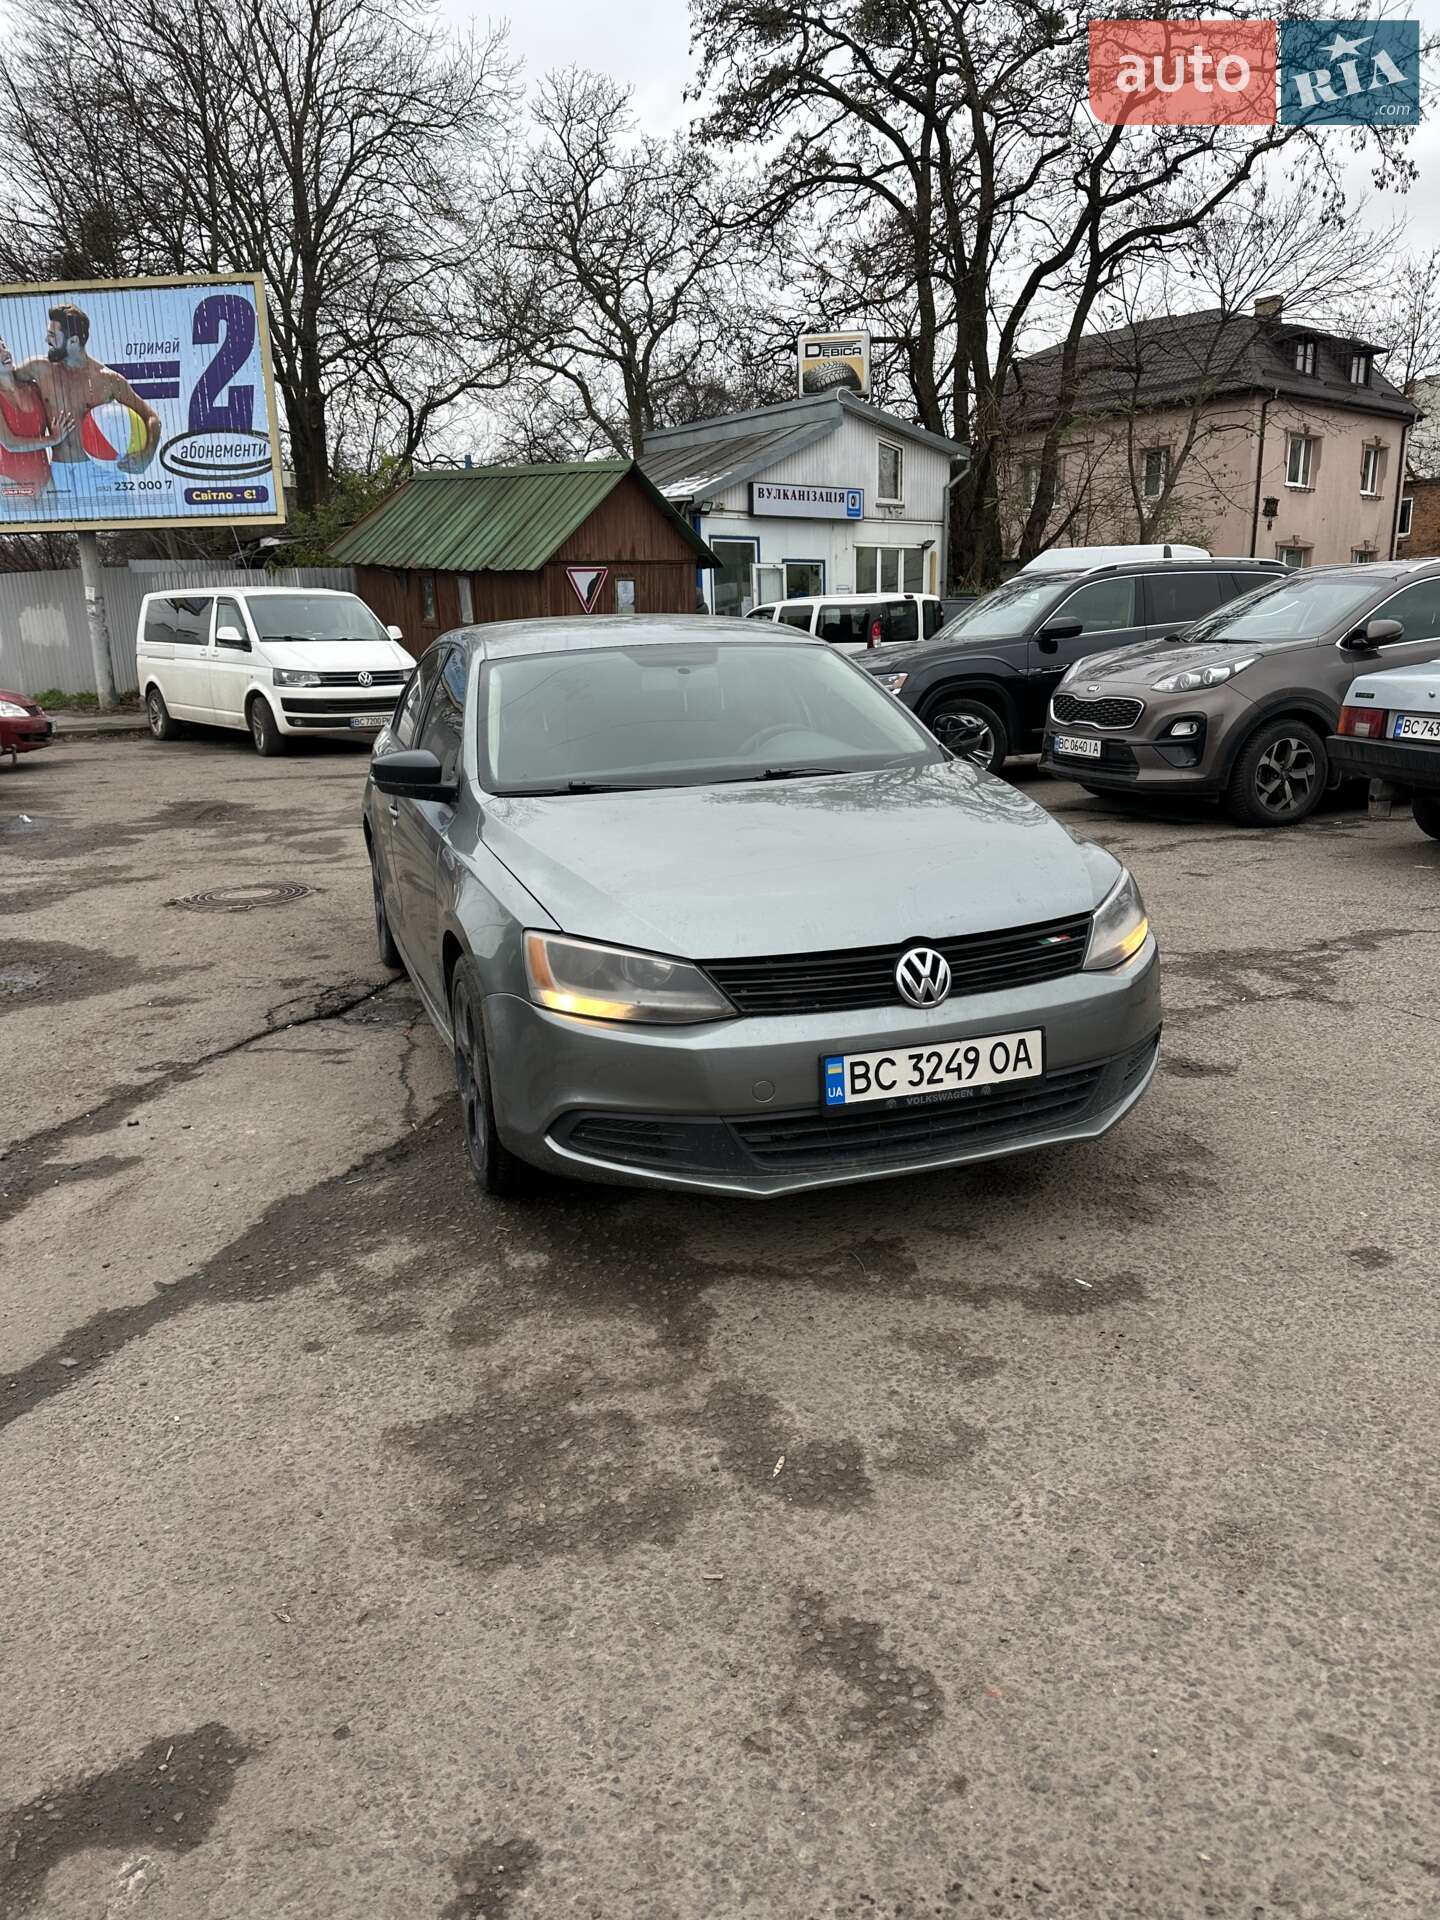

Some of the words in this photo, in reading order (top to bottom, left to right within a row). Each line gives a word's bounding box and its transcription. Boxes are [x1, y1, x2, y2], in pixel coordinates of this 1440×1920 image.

[125, 337, 180, 359] отримай
[180, 441, 267, 459] абонементи
[114, 481, 136, 491] 232
[138, 480, 162, 490] 000
[165, 480, 172, 490] 7
[192, 489, 234, 500] Світло
[757, 487, 846, 504] ВУЛКАНІЗАЦІЯ
[1403, 719, 1420, 735] BC
[1058, 738, 1070, 750] BC
[1070, 739, 1088, 753] 0640
[1088, 742, 1099, 755] IA
[850, 1057, 898, 1095] BC
[908, 1046, 980, 1087] 3249
[989, 1038, 1033, 1074] OA
[828, 1087, 843, 1098] UA
[906, 1089, 974, 1106] VOLKSWAGEN
